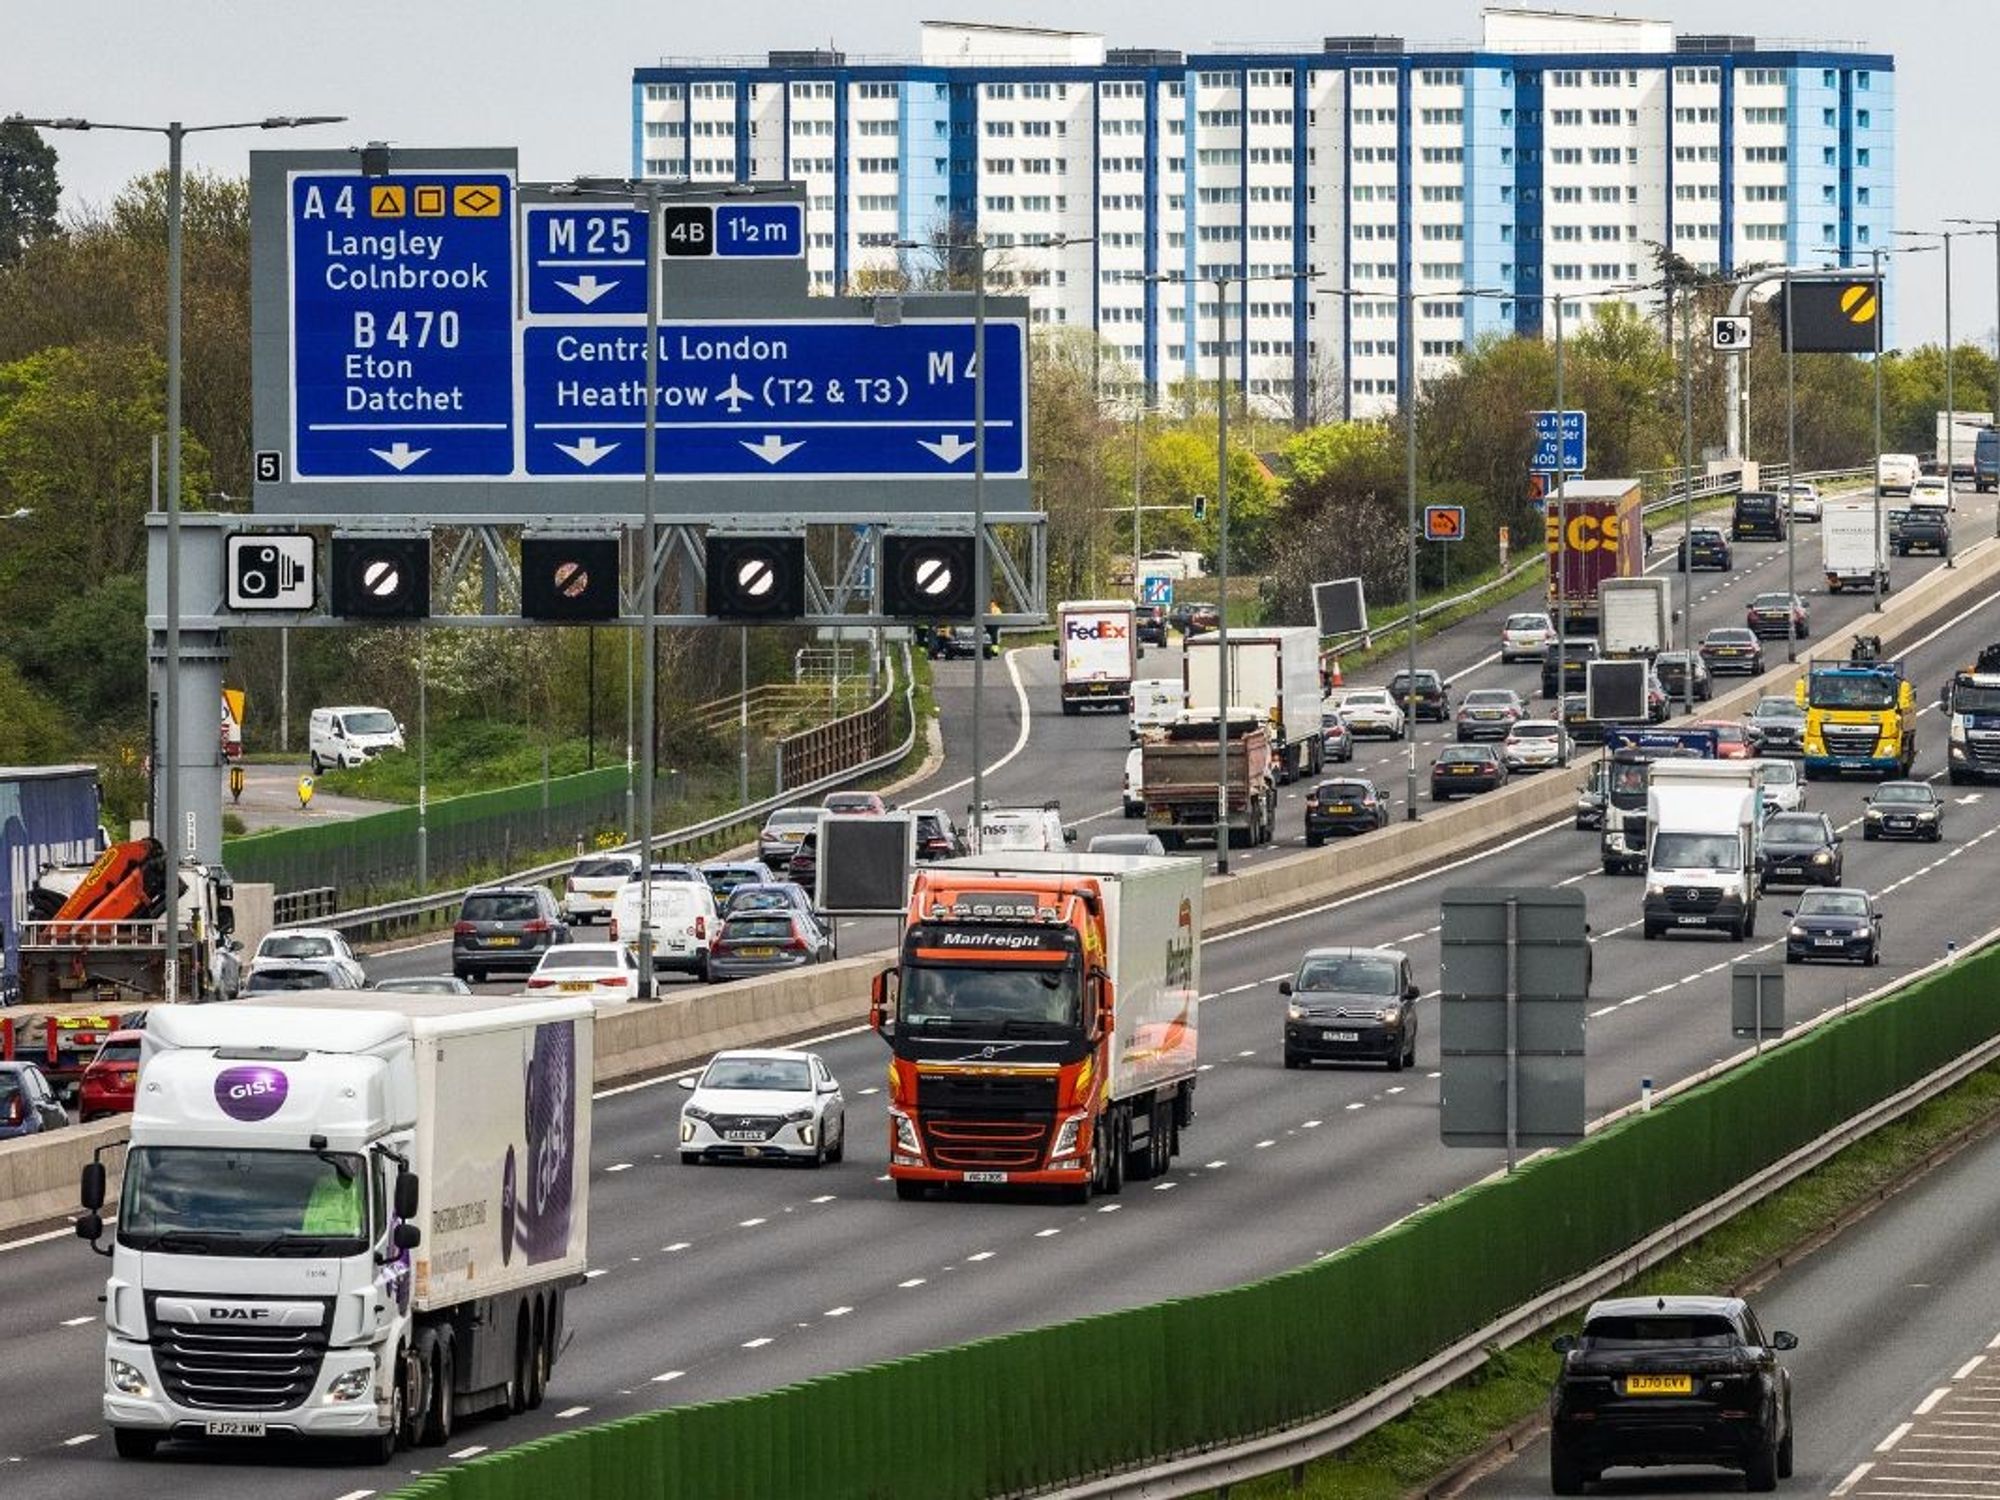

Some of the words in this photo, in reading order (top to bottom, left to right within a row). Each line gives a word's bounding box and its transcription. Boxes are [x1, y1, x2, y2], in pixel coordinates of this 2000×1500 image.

[670, 222, 705, 242] 4B
[326, 229, 443, 260] Langley
[326, 262, 488, 290] Colnbrook
[681, 335, 788, 361] London
[345, 354, 413, 379] Eton
[345, 386, 463, 412] Datchet
[557, 379, 708, 407] Heathrow
[826, 378, 845, 404] &
[260, 457, 275, 478] 5
[1066, 620, 1127, 641] FedEx
[942, 933, 1040, 948] Manfreight
[210, 1308, 270, 1320] DAF
[1632, 1377, 1661, 1389] BJ70
[210, 1422, 238, 1433] FJ72
